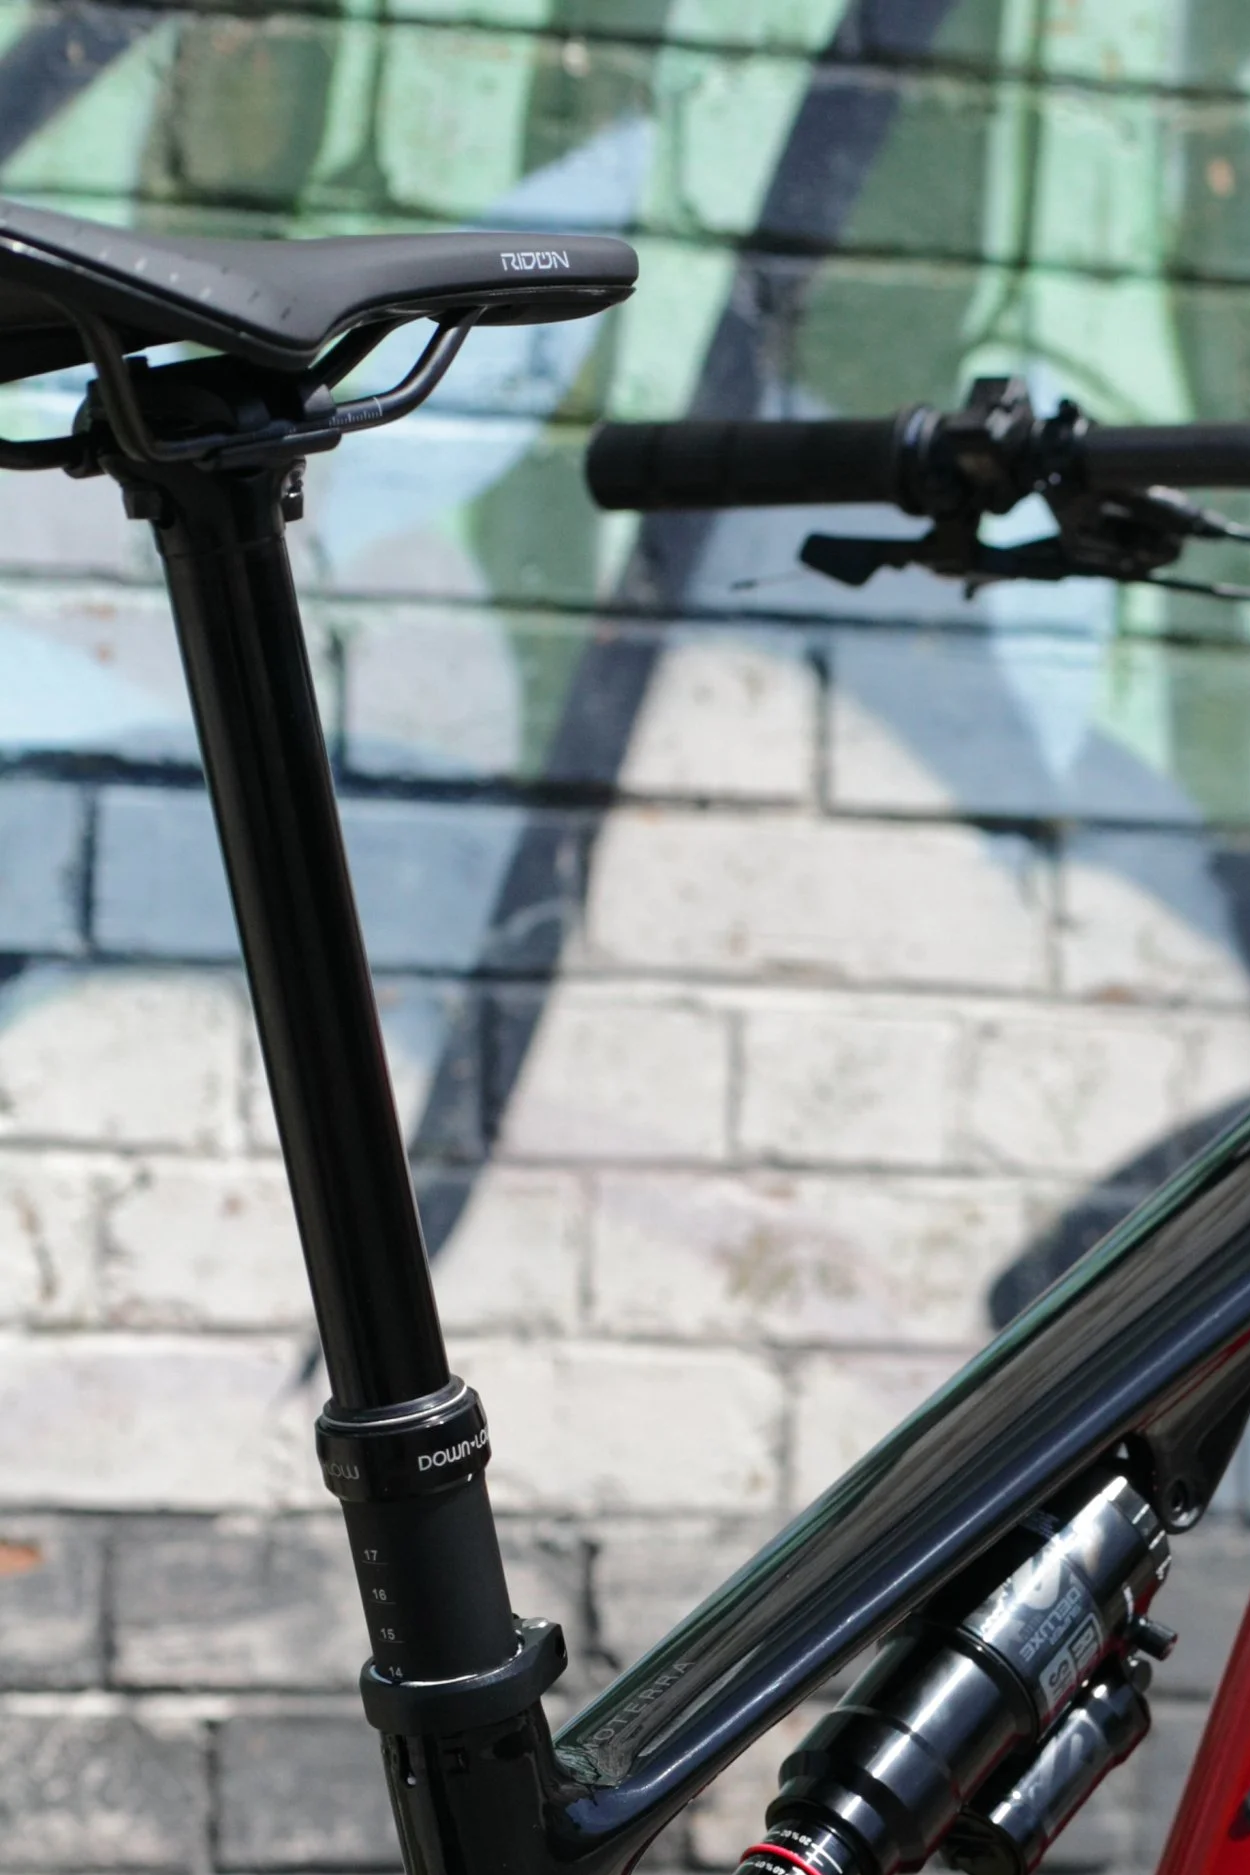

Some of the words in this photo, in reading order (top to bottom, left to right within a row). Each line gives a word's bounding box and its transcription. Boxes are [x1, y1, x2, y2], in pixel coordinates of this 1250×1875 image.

[500, 250, 570, 272] RIDON
[363, 1549, 378, 1561] 17
[371, 1588, 387, 1601] 16
[1018, 1586, 1082, 1662] DELUXE
[380, 1628, 396, 1641] 15
[388, 1666, 403, 1678] 14
[583, 1661, 696, 1756] MOTERRA
